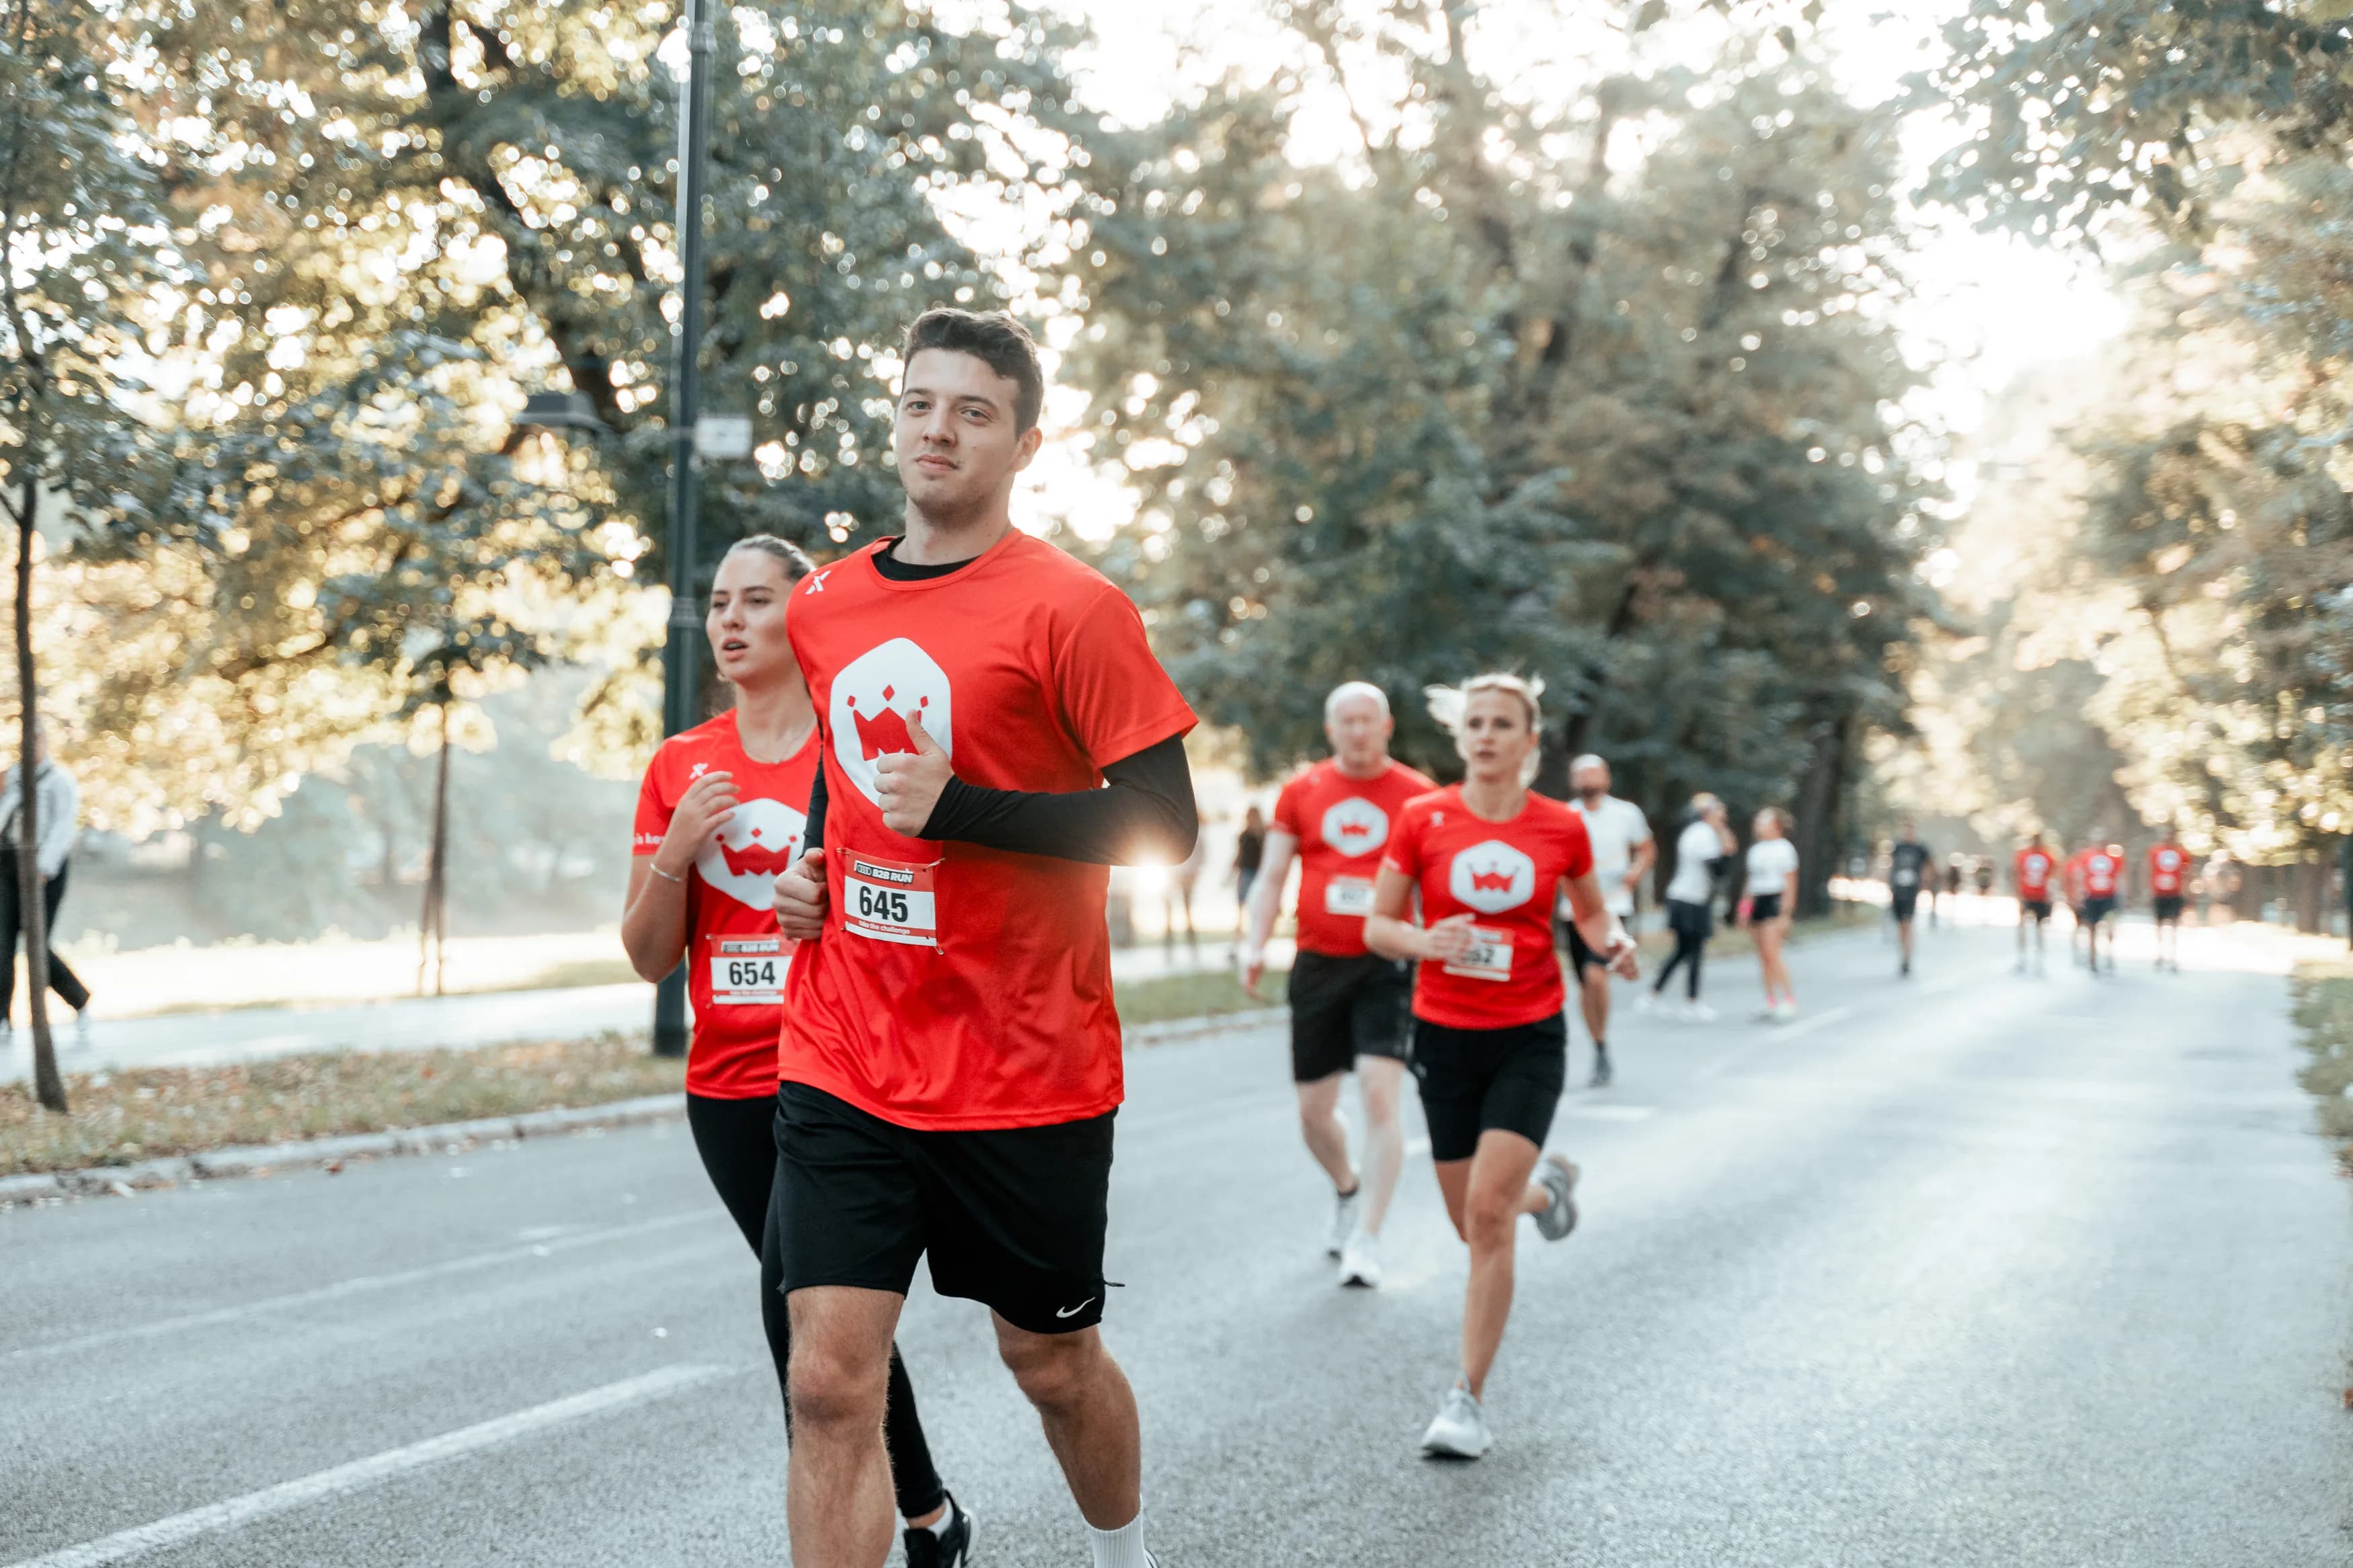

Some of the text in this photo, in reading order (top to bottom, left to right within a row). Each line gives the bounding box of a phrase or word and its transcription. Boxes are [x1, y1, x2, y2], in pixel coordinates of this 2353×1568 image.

[873, 868, 913, 883] B2B RUN
[860, 885, 908, 923] 645
[871, 922, 880, 930] the
[881, 925, 910, 935] challenge
[729, 961, 776, 985] 654
